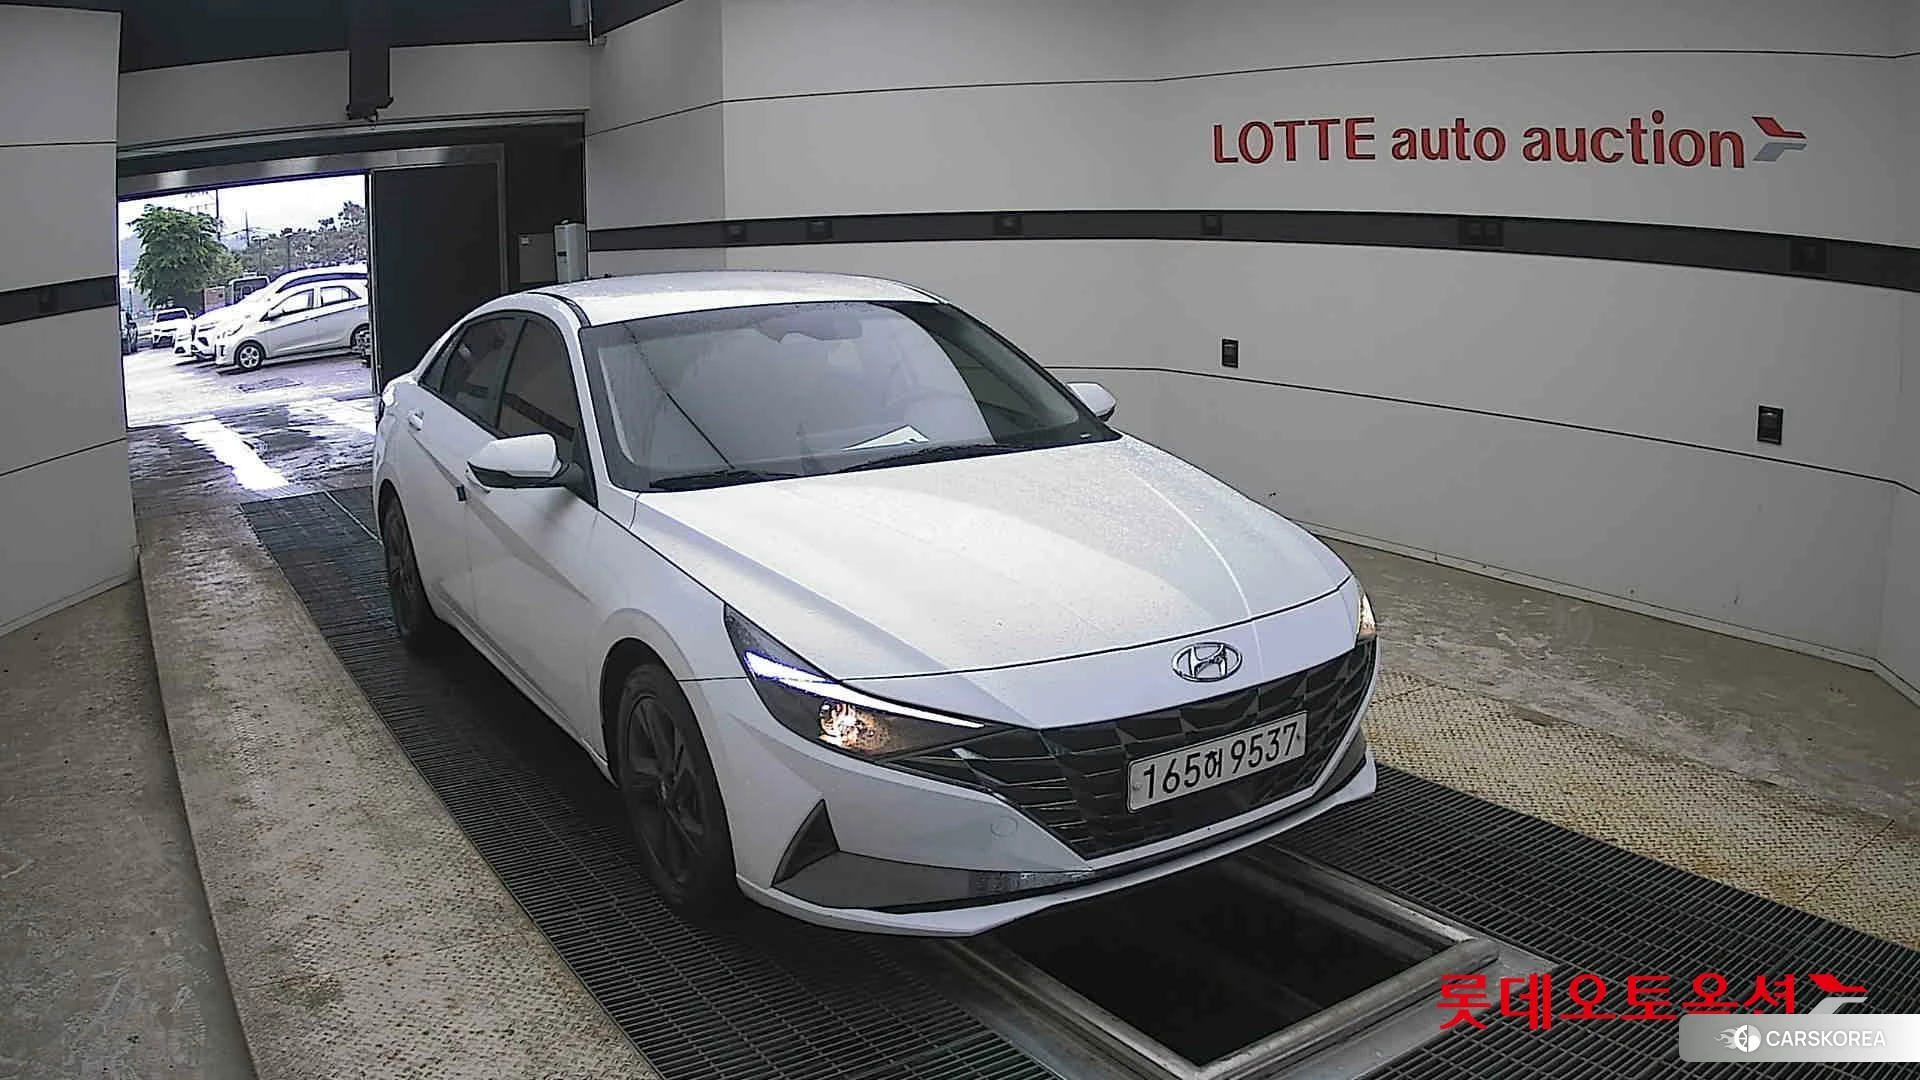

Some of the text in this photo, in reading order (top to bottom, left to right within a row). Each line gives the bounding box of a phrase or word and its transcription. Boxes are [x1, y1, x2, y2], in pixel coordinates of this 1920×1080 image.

[1213, 110, 1745, 168] LOTTE auto auction
[1143, 722, 1299, 799] 165허 9537
